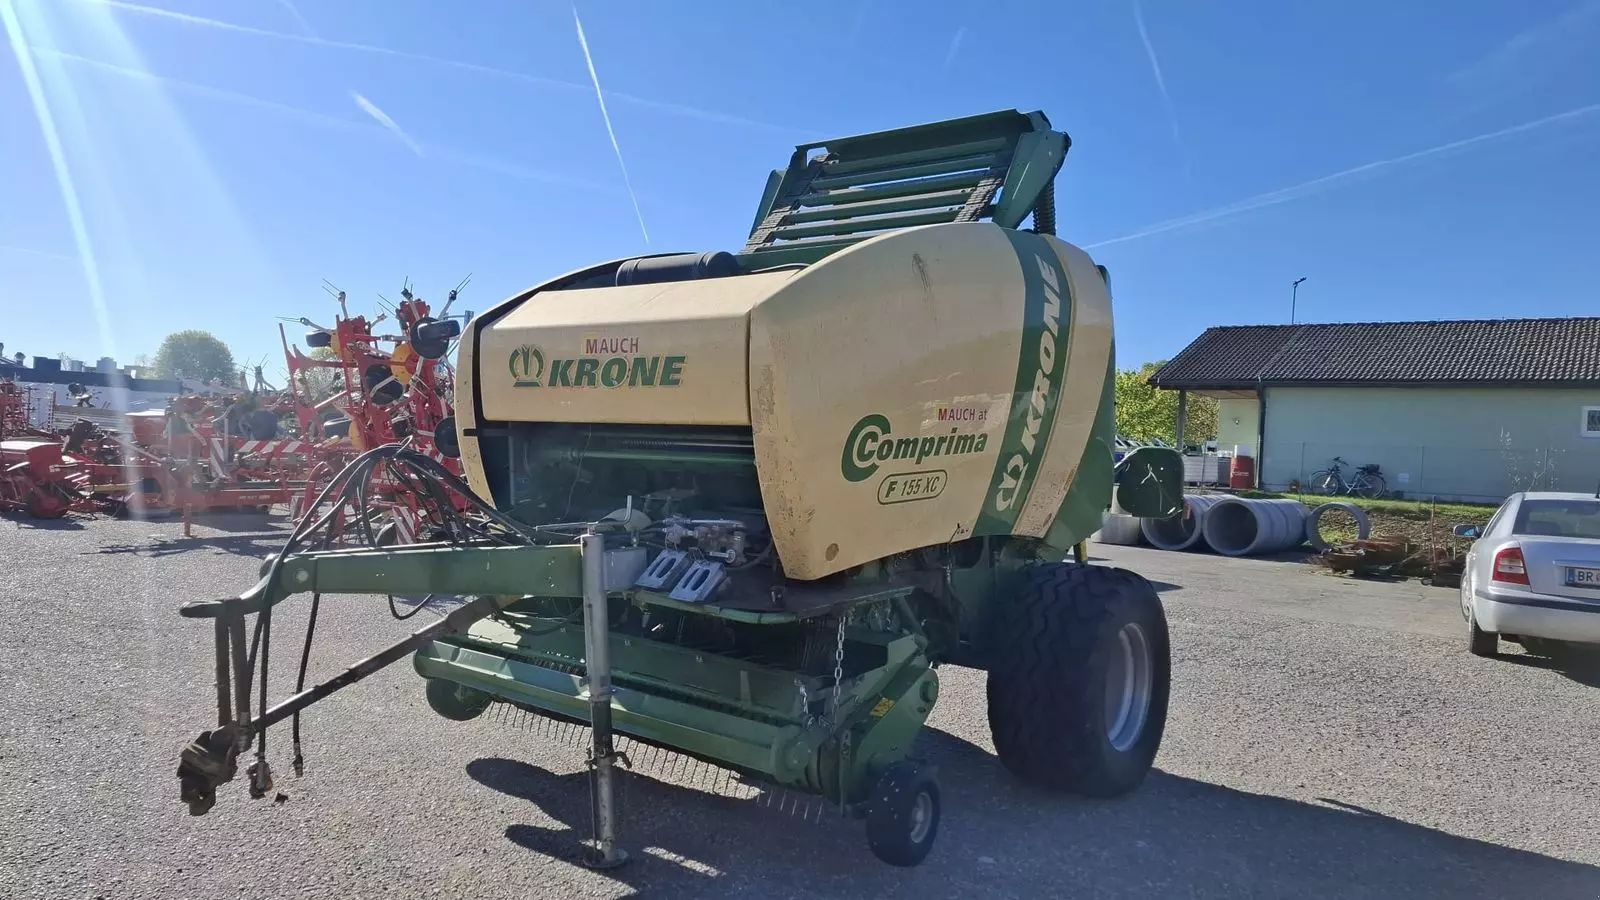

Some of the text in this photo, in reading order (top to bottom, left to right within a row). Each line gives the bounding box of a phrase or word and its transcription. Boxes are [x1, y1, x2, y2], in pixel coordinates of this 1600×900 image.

[586, 337, 639, 354] MAUCH
[1021, 253, 1060, 454] KRONE
[548, 356, 686, 388] KRONE
[938, 408, 988, 421] MAUCH at
[885, 476, 940, 498] F 155 XC
[1577, 570, 1594, 583] BR
